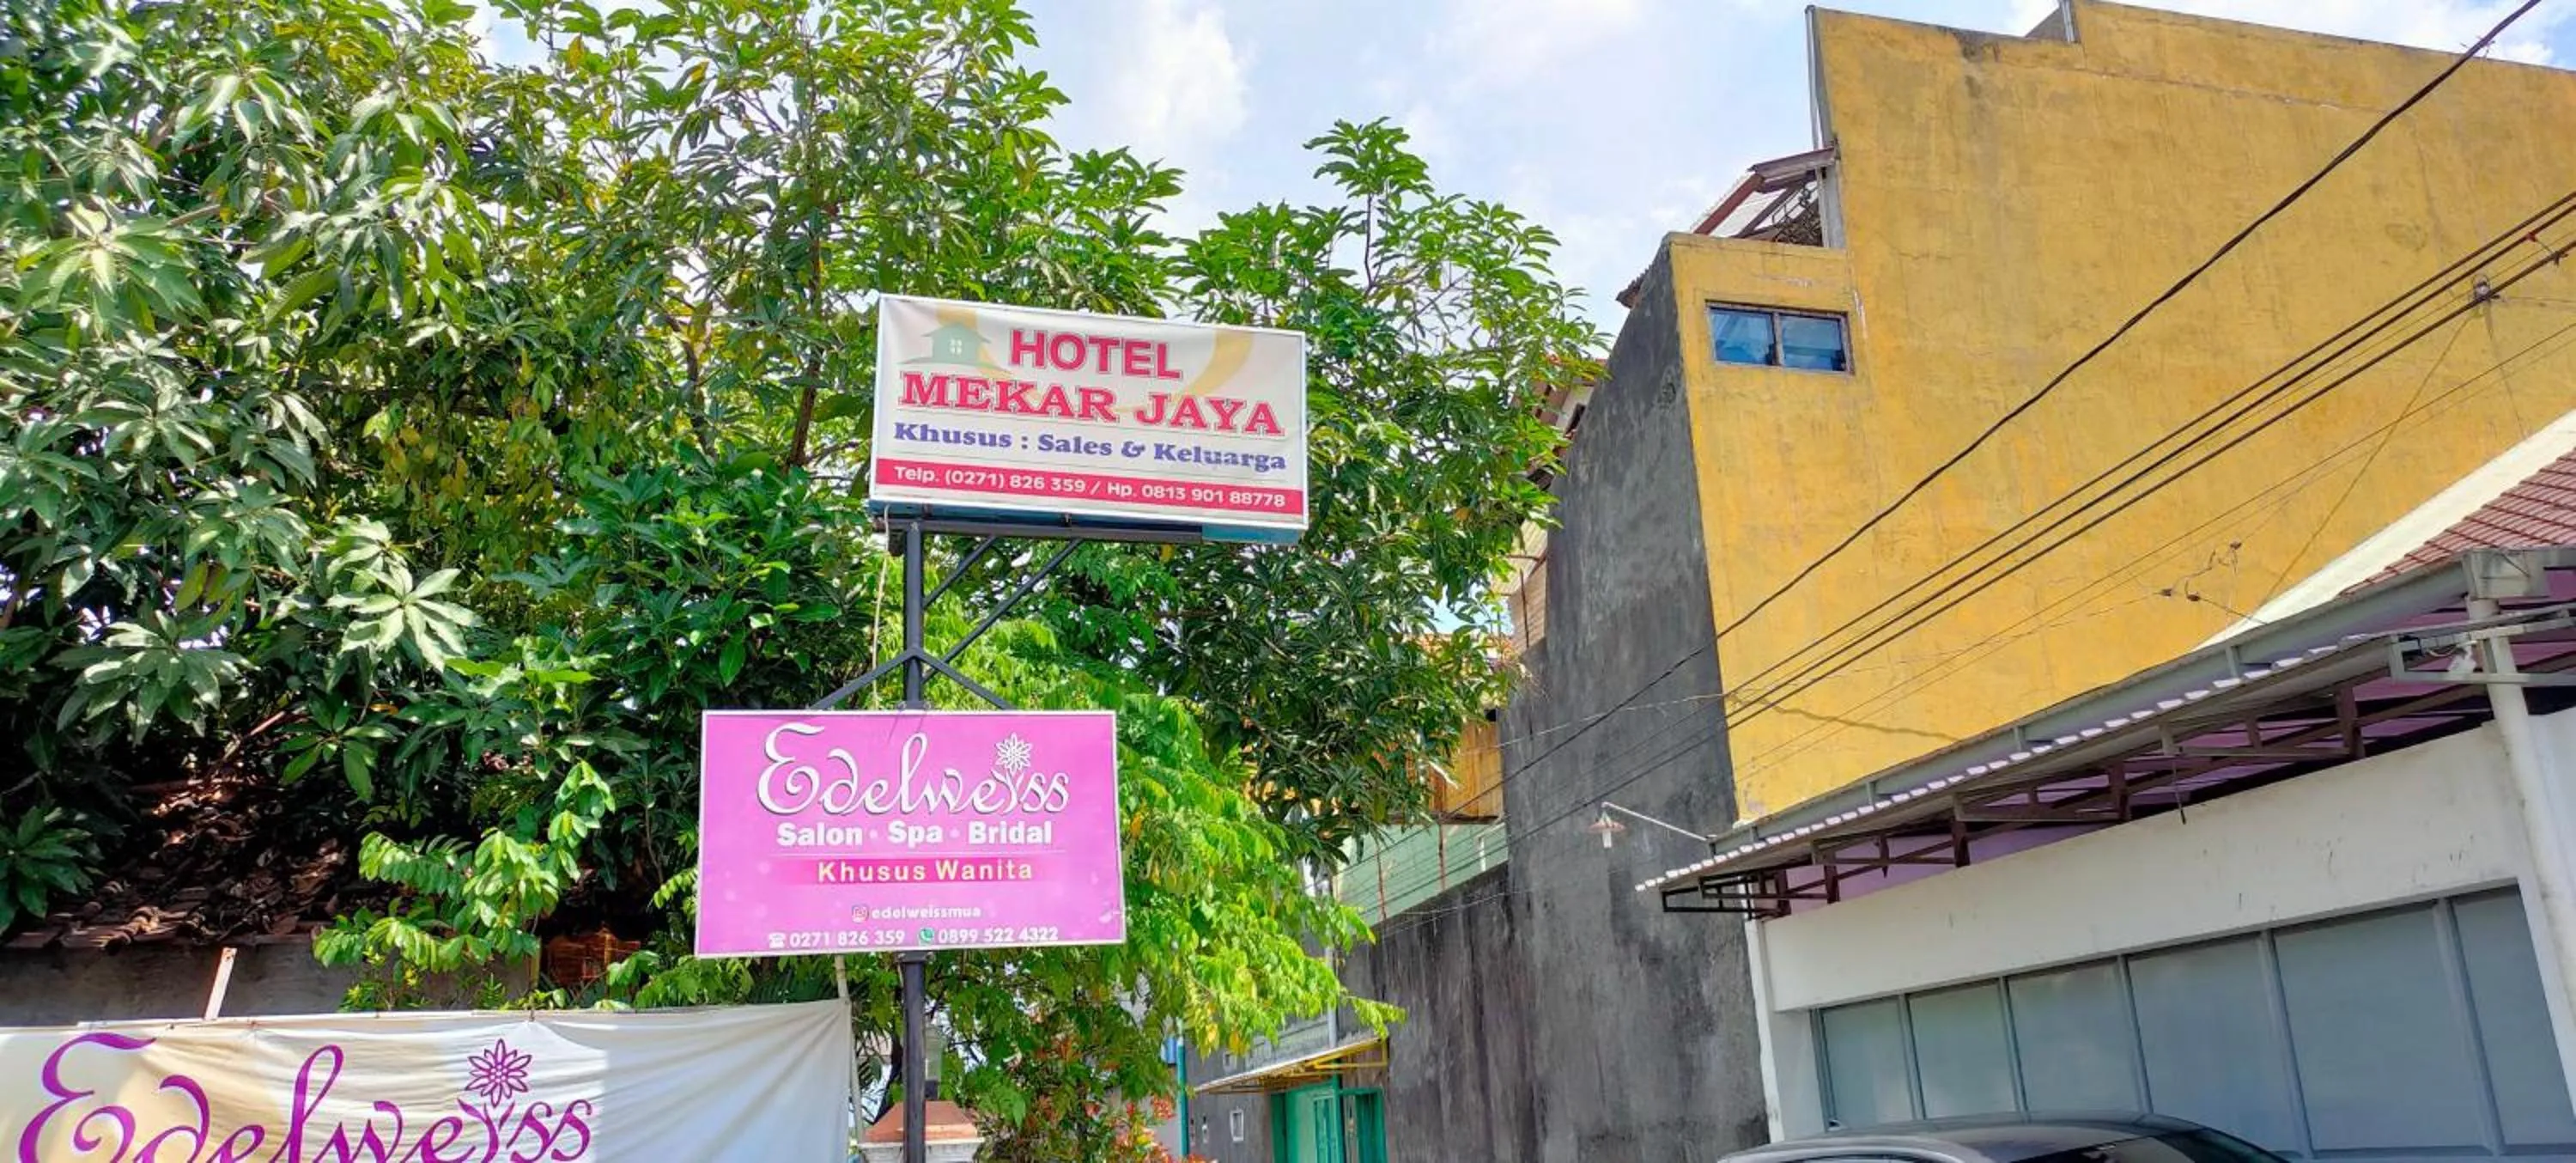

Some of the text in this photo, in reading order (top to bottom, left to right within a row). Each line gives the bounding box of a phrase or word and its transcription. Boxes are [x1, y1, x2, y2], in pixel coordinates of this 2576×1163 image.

[1009, 329, 1182, 380] HOTEL
[898, 371, 1285, 436] MEKAR JAYA
[893, 421, 1013, 448] Khusus
[1036, 433, 1113, 456] Sales
[1121, 440, 1146, 459] &
[1153, 442, 1287, 472] Keluarga
[894, 466, 939, 484] Telp.
[944, 468, 1005, 491] (0271)
[1009, 474, 1046, 490] 826
[1050, 478, 1086, 494] 359
[1107, 481, 1138, 500] Hp.
[1141, 484, 1188, 502] 0813
[1191, 489, 1225, 504] 901
[1230, 491, 1286, 508] 88778
[756, 722, 1071, 816] Edelweiss
[776, 820, 1053, 849] Salon Spa Bridal
[817, 859, 1033, 881] Khusus Wanita
[872, 904, 981, 919] edelweissmua
[789, 927, 1059, 947] 0271 826 359 0899 522 4322
